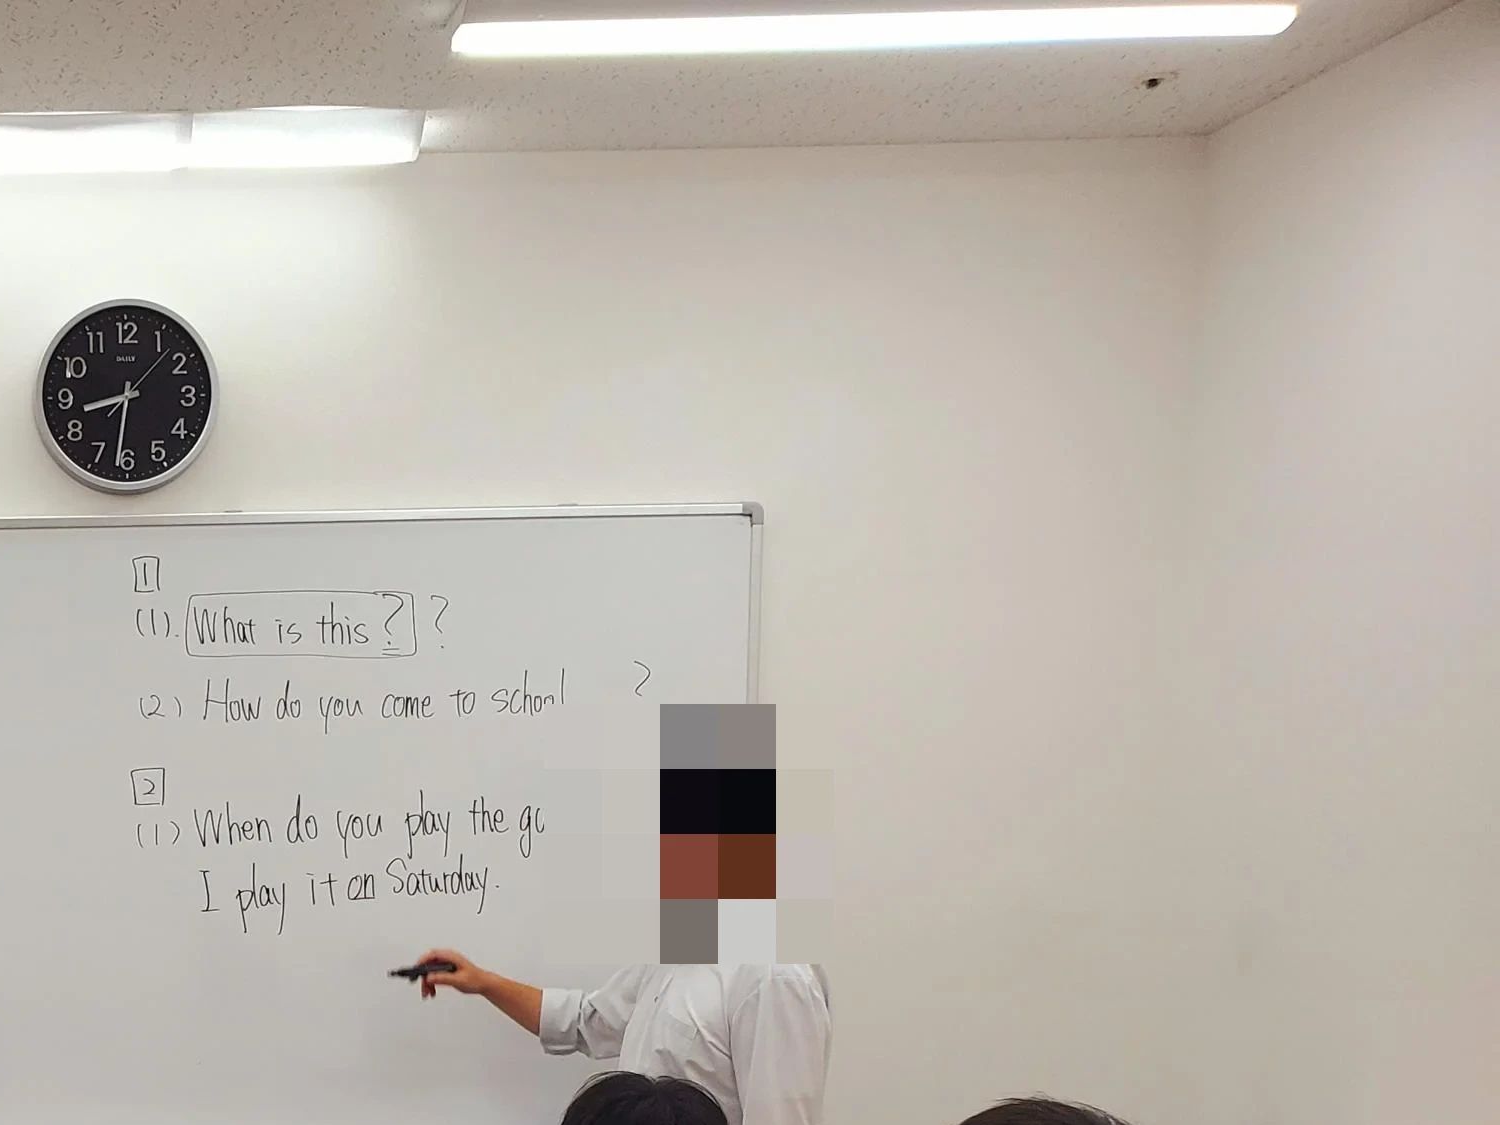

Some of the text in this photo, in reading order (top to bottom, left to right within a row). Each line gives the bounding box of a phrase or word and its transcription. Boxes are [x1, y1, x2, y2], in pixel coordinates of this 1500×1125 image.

[87, 331, 104, 353] 11
[116, 322, 138, 344] 12
[155, 331, 161, 352] 1
[64, 356, 87, 378] 10
[172, 353, 187, 374] 2
[58, 388, 73, 409] 9
[180, 385, 196, 407] 3
[67, 419, 82, 441] 8
[171, 417, 187, 439] 4
[91, 442, 105, 463] 7
[120, 449, 135, 470] 6
[151, 440, 165, 461] 5
[194, 606, 255, 644] What
[275, 619, 302, 644] is
[203, 678, 261, 723] How
[277, 680, 300, 719] do
[320, 696, 363, 734] you
[382, 694, 434, 718] come
[449, 689, 475, 717] to
[194, 802, 272, 847] When
[287, 794, 317, 843] do
[337, 811, 382, 858] you
[405, 789, 450, 859] play
[468, 796, 509, 835] the
[200, 870, 220, 912] I
[236, 863, 285, 935] play
[306, 873, 337, 906] it
